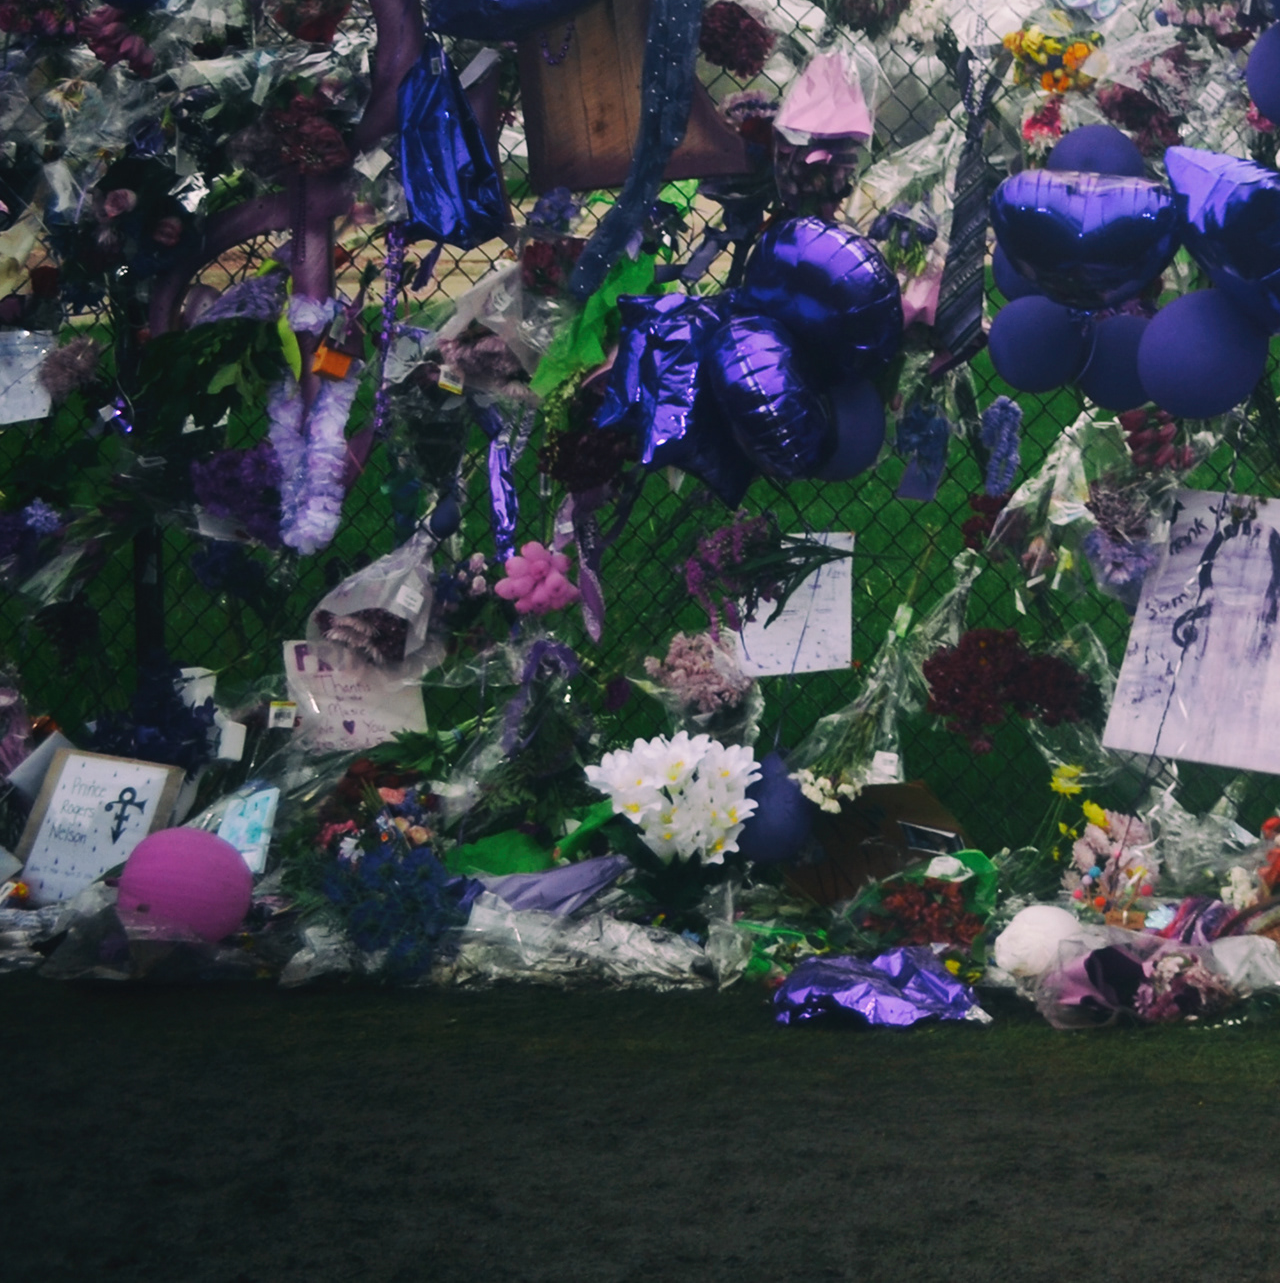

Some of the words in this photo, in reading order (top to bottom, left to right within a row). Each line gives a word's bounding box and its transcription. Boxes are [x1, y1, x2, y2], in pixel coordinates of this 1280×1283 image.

[362, 718, 387, 734] You
[71, 775, 107, 798] Prince
[60, 799, 96, 826] Rogers
[49, 824, 87, 844] Nelson
